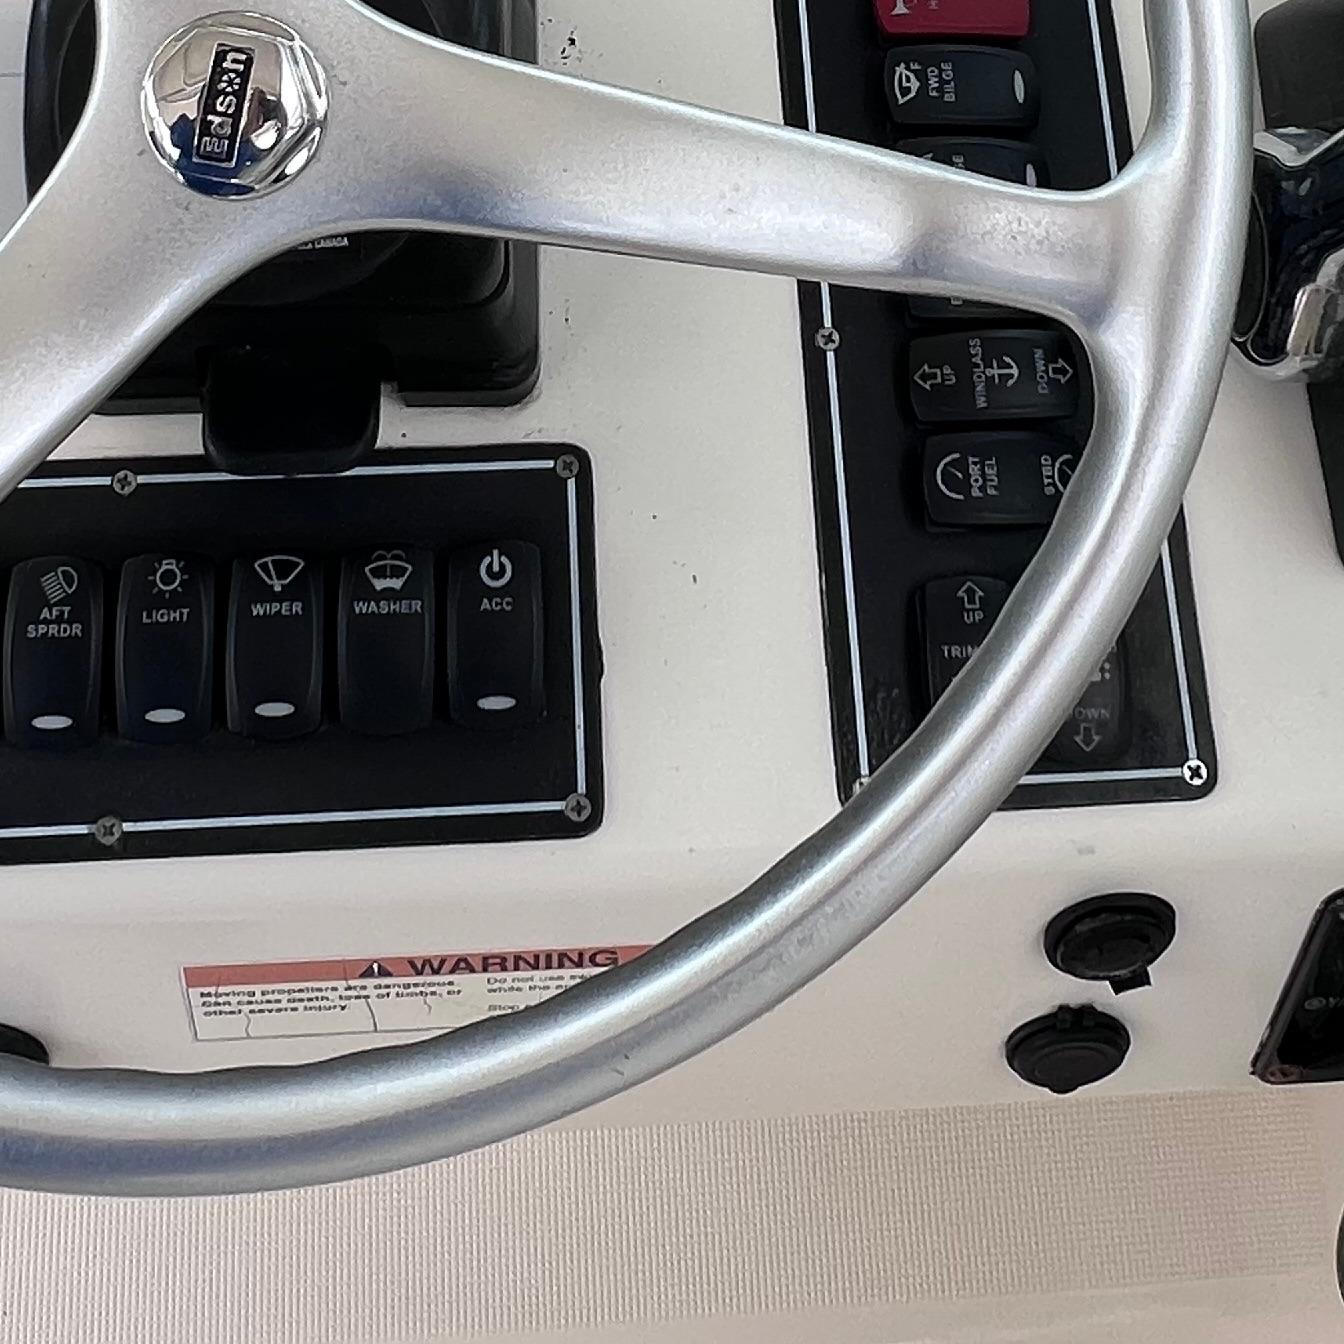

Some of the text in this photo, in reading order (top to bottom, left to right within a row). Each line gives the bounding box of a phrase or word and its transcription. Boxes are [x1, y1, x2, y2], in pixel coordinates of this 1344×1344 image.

[927, 66, 940, 97] FWD
[941, 62, 956, 102] BILGE
[942, 365, 957, 385] UP
[968, 337, 989, 409] WINDLASS
[1031, 347, 1049, 394] DOWN
[967, 456, 984, 498] PORT
[984, 456, 1000, 496] FUEL
[1040, 454, 1056, 496] STBD
[39, 606, 72, 622] AFT
[251, 601, 304, 617] WIPER
[353, 600, 423, 616] WASHER
[480, 597, 514, 612] ACC
[142, 608, 190, 625] LIGHT
[962, 610, 985, 625] UP
[26, 623, 83, 639] SPRDR
[1073, 707, 1112, 720] OWN
[407, 949, 619, 976] WARNING
